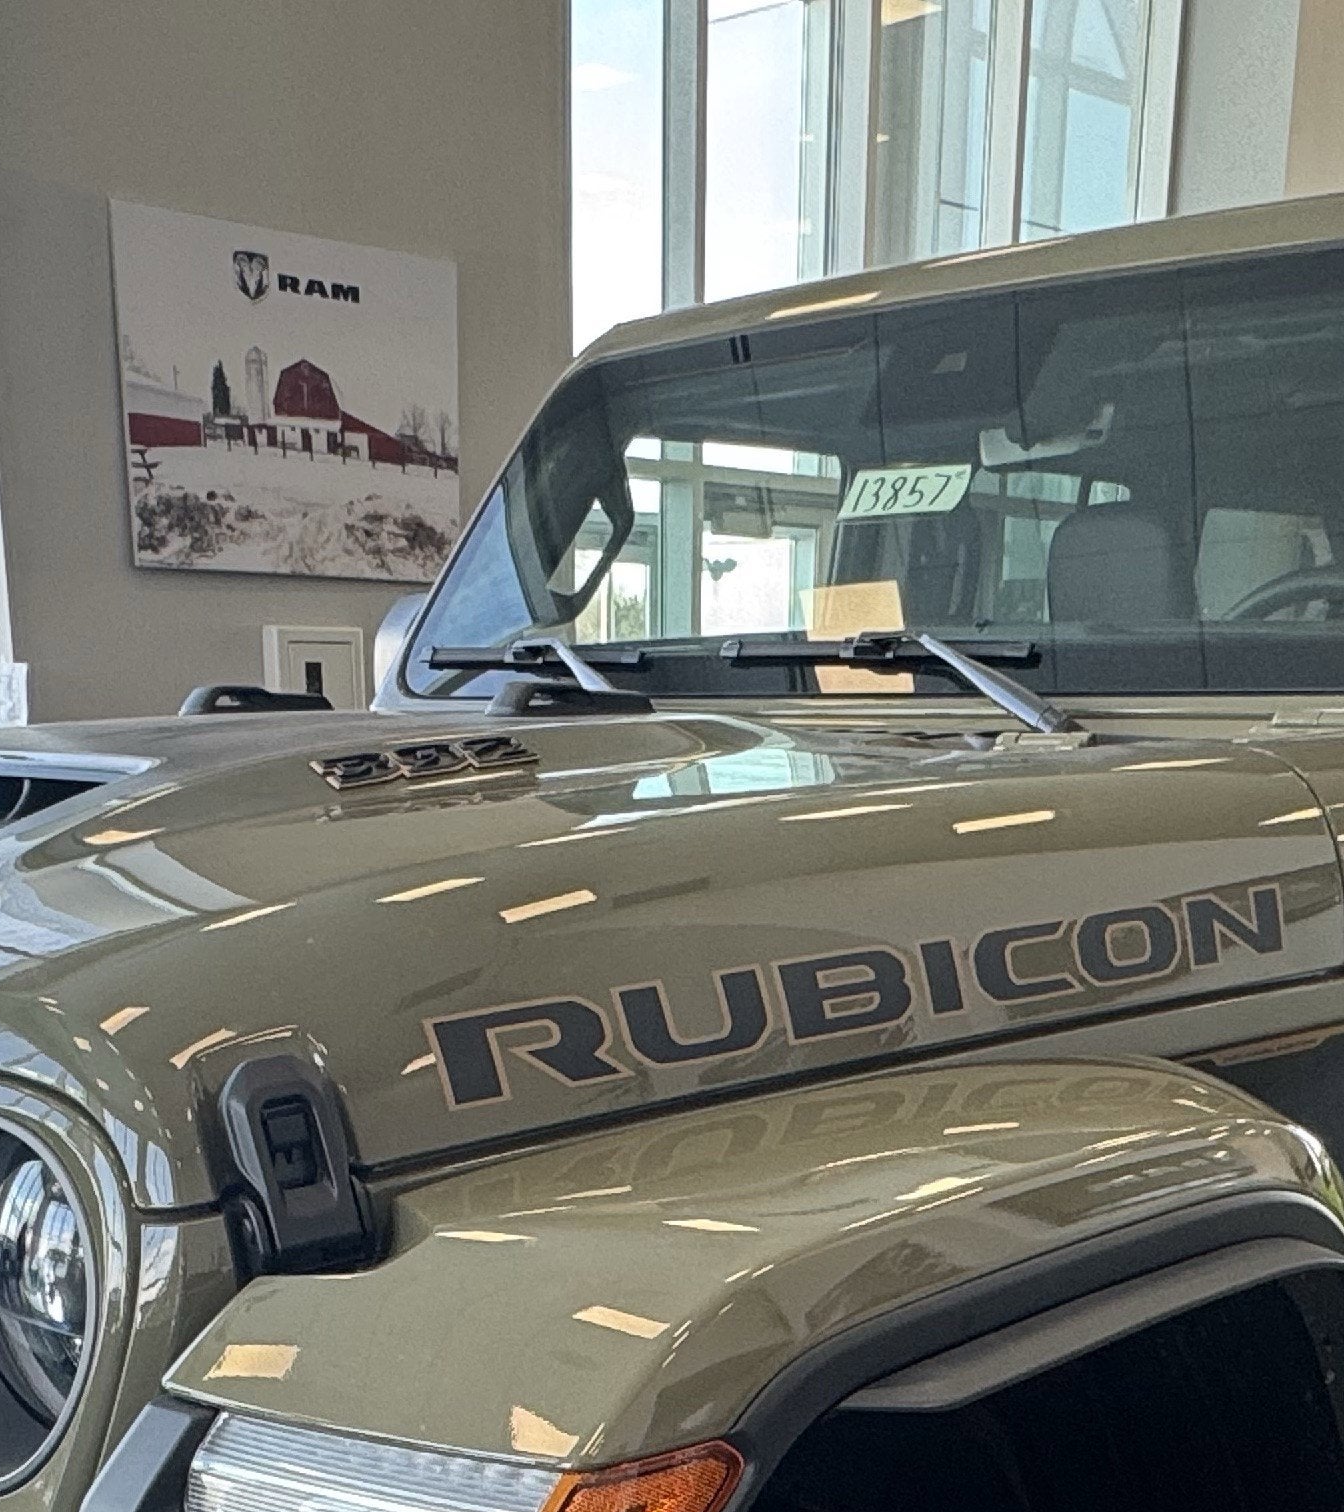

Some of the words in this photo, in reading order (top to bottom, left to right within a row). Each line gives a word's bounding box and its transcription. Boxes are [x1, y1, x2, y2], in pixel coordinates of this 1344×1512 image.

[276, 272, 361, 304] RAM
[852, 473, 953, 513] 13857
[422, 886, 1285, 1111] RUBICON
